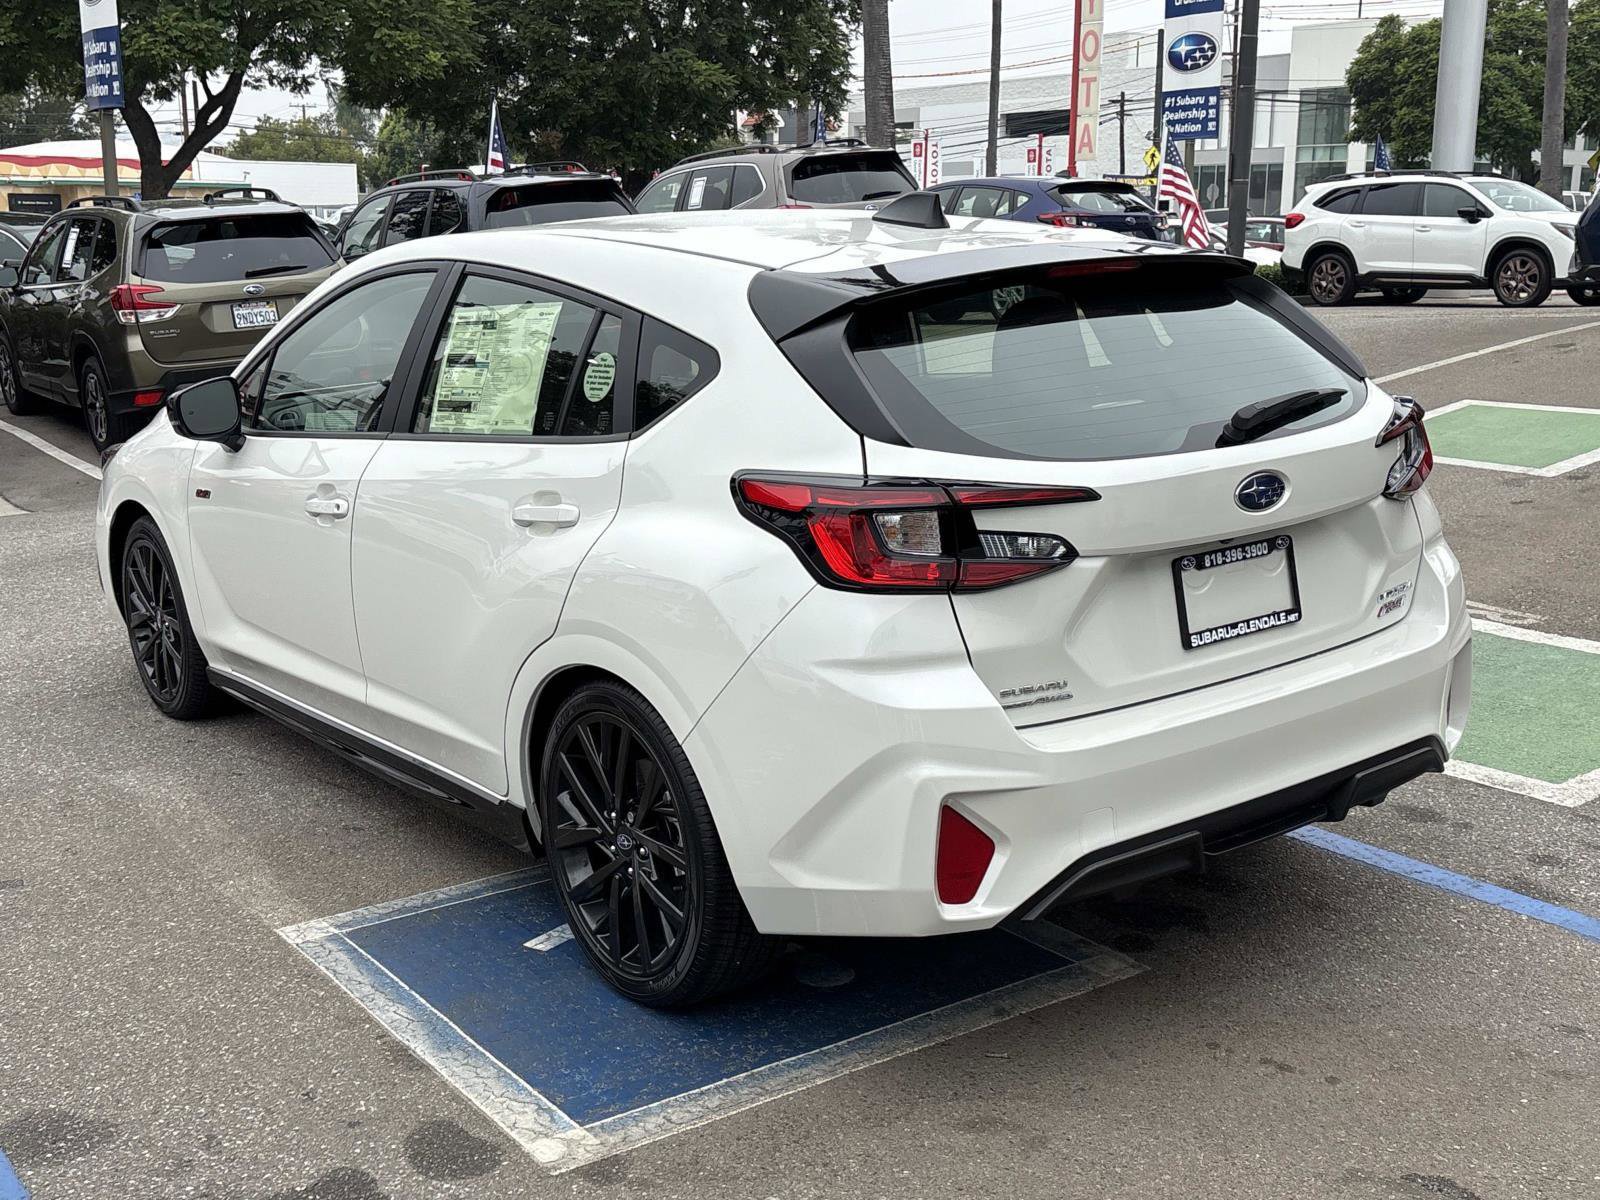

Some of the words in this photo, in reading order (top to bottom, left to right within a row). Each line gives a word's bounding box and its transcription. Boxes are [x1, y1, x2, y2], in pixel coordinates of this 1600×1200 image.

[89, 41, 107, 55] Subaru
[85, 60, 111, 78] Dealership
[1165, 97, 1175, 107] #1
[1176, 95, 1205, 106] Subaru
[1163, 108, 1206, 120] Dealership
[1174, 122, 1202, 133] Nation
[1204, 542, 1269, 567] 818-396-3900
[999, 680, 1068, 697] SUBARU
